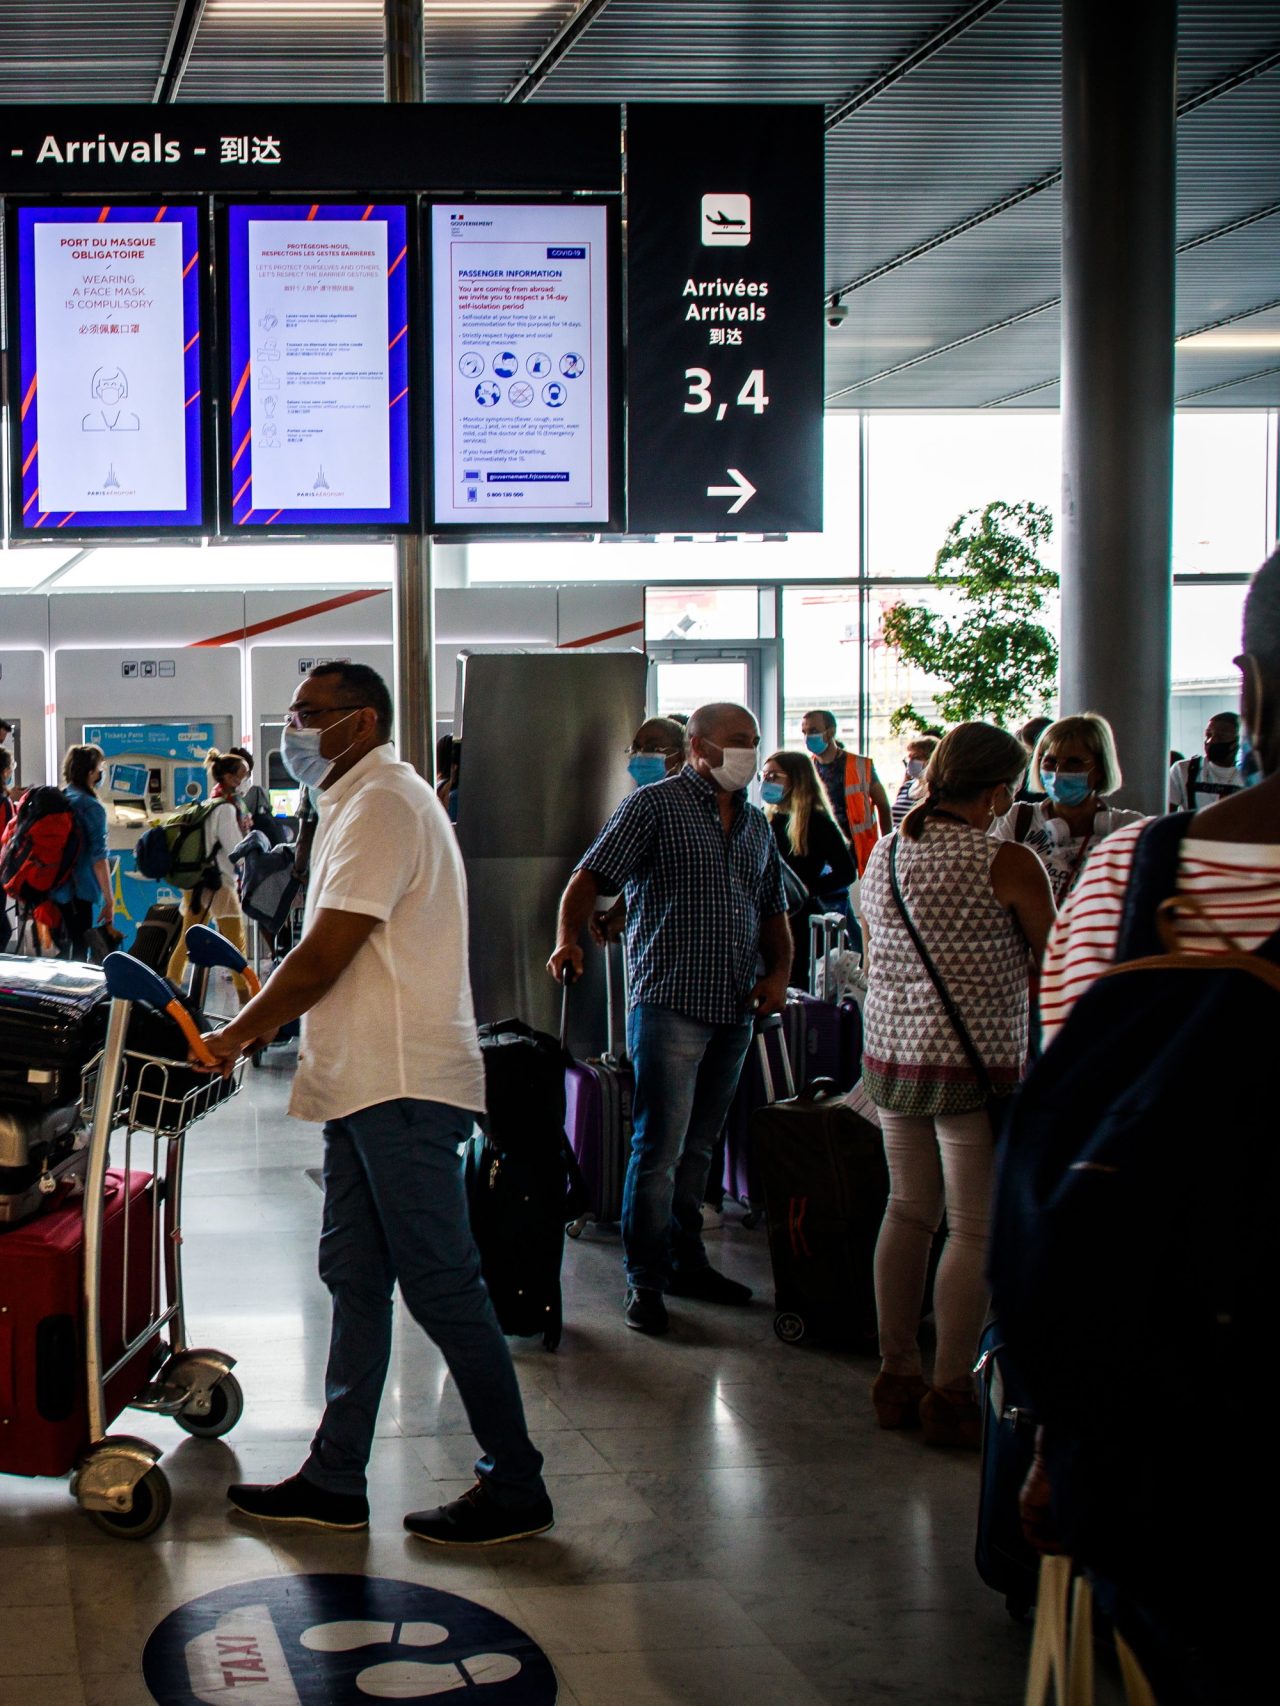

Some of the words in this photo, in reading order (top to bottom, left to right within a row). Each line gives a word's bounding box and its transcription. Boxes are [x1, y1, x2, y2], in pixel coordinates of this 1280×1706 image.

[36, 133, 181, 163] Arrivals
[220, 136, 281, 164] 到达
[60, 238, 89, 247] PORT
[92, 238, 107, 247] DU
[110, 238, 156, 247] MASQUE
[72, 250, 145, 259] OBLIGATOIRE
[82, 275, 135, 284] WEARING
[682, 278, 768, 297] Arrivées
[73, 288, 80, 296] A
[84, 288, 111, 296] FACE
[115, 288, 145, 296] MASK
[65, 300, 74, 309] IS
[78, 300, 154, 309] COMPULSORY
[685, 303, 766, 321] Arrivals
[709, 328, 742, 345] 到达
[215, 1636, 269, 1687] TAXI
